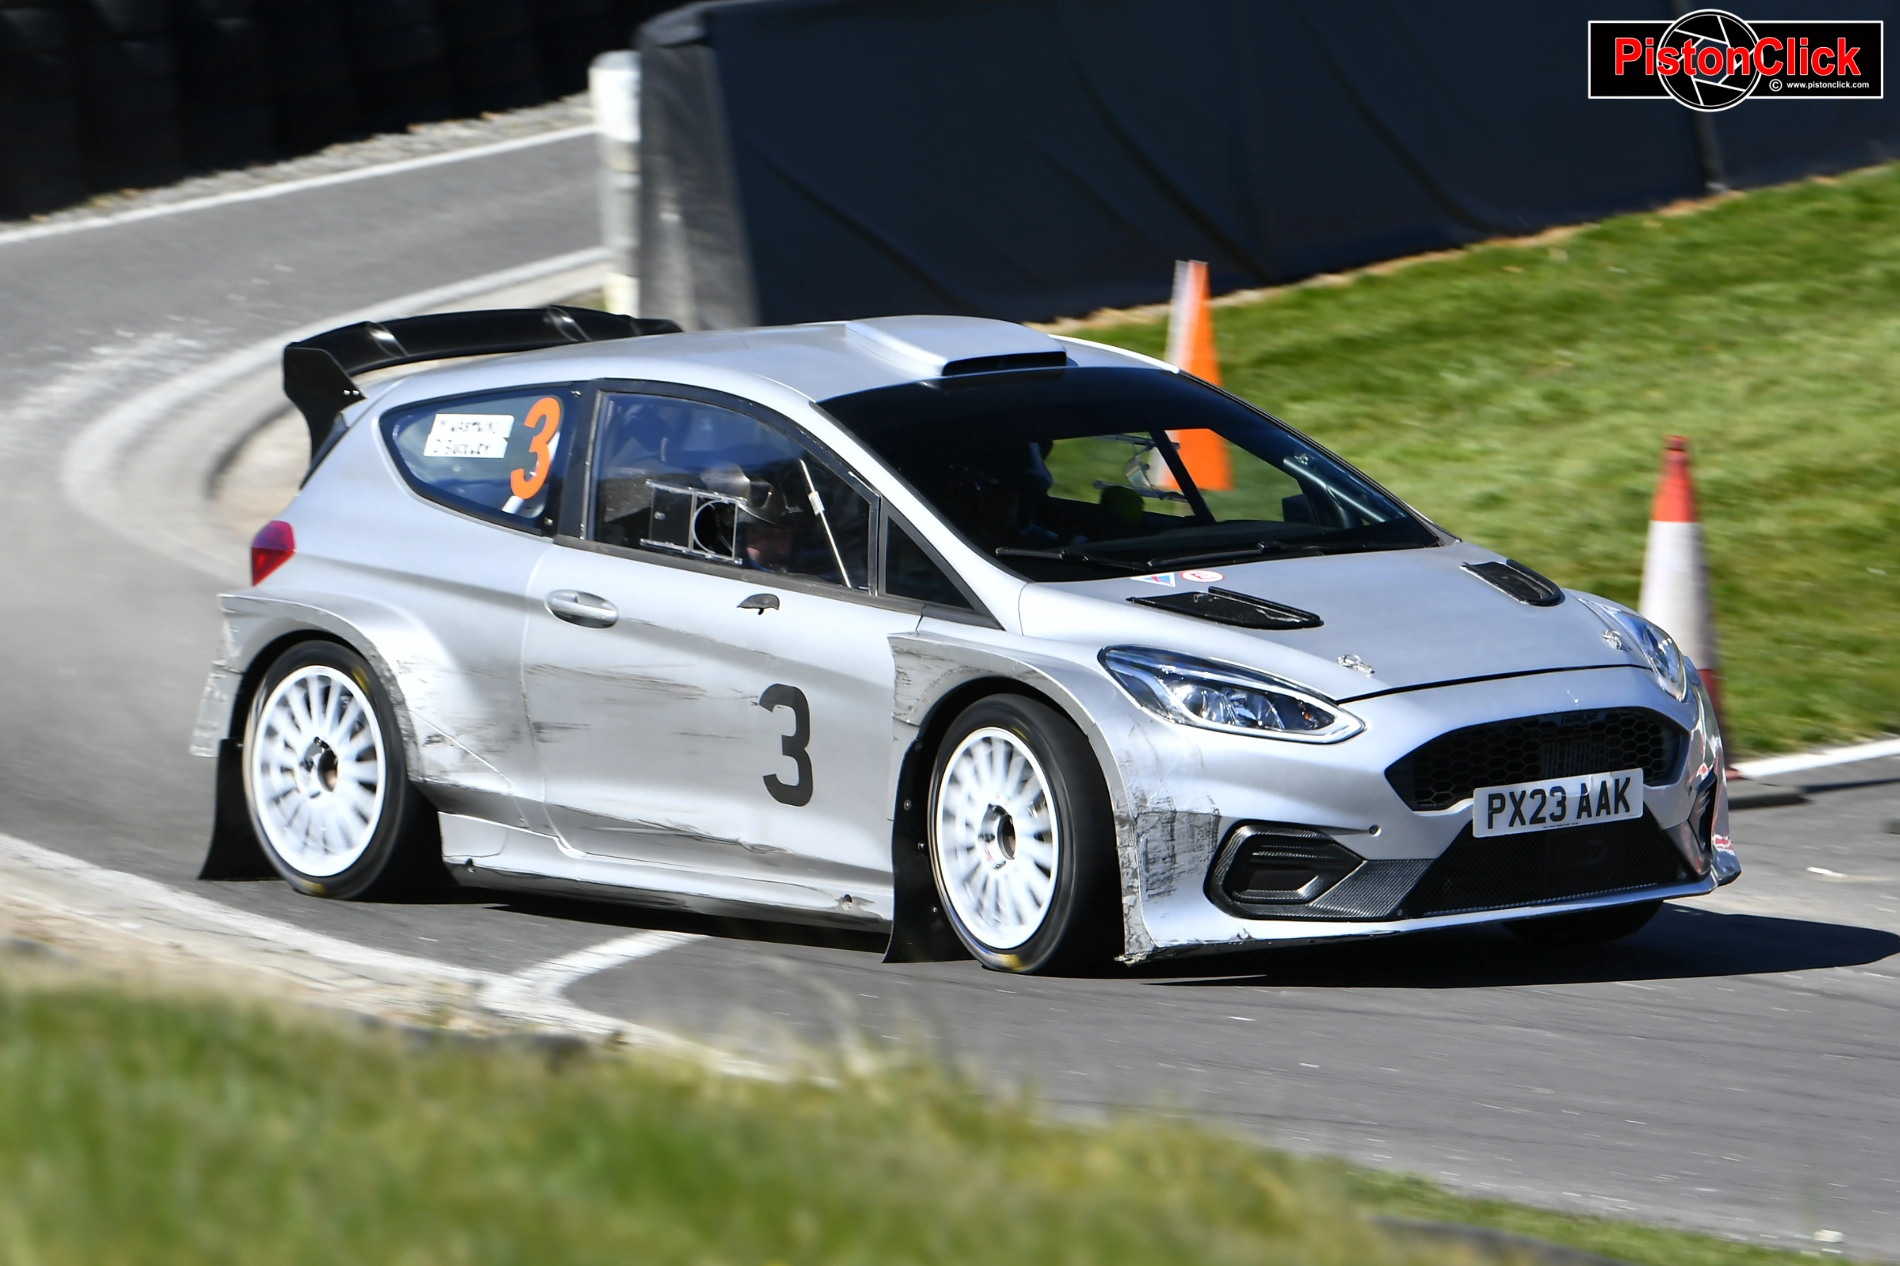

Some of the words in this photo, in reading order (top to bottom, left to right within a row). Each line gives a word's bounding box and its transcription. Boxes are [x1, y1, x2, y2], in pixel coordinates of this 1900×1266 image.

[510, 396, 561, 500] 3
[758, 683, 814, 807] 3
[1487, 785, 1567, 830] PX23
[1576, 776, 1631, 820] AAK
